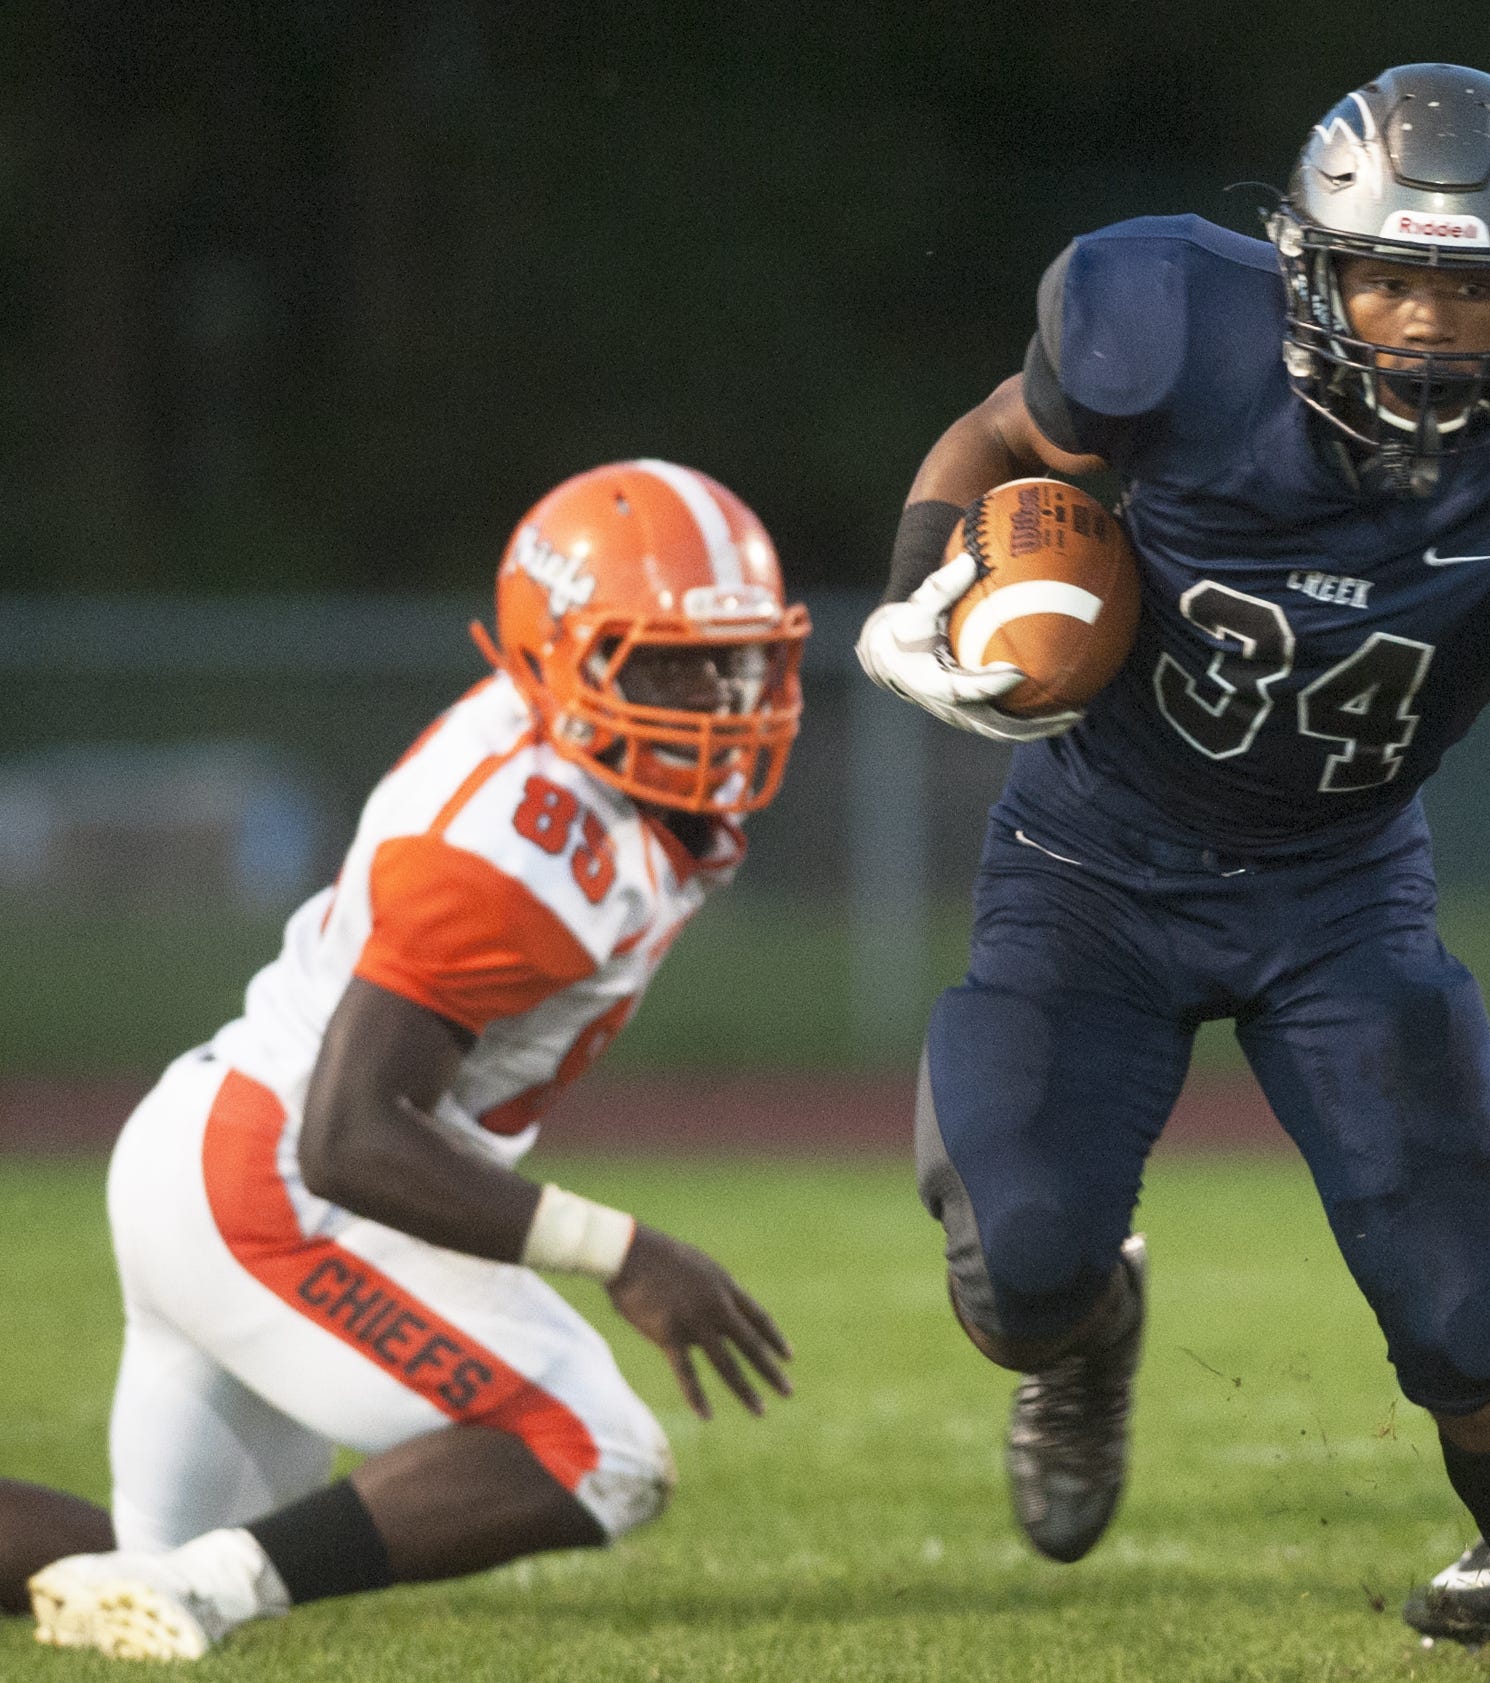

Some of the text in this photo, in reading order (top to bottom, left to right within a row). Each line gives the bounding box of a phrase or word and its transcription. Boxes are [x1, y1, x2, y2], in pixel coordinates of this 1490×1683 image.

[1399, 217, 1477, 239] Riddell
[1153, 579, 1436, 793] 34
[296, 1257, 493, 1410] CHIEFS
